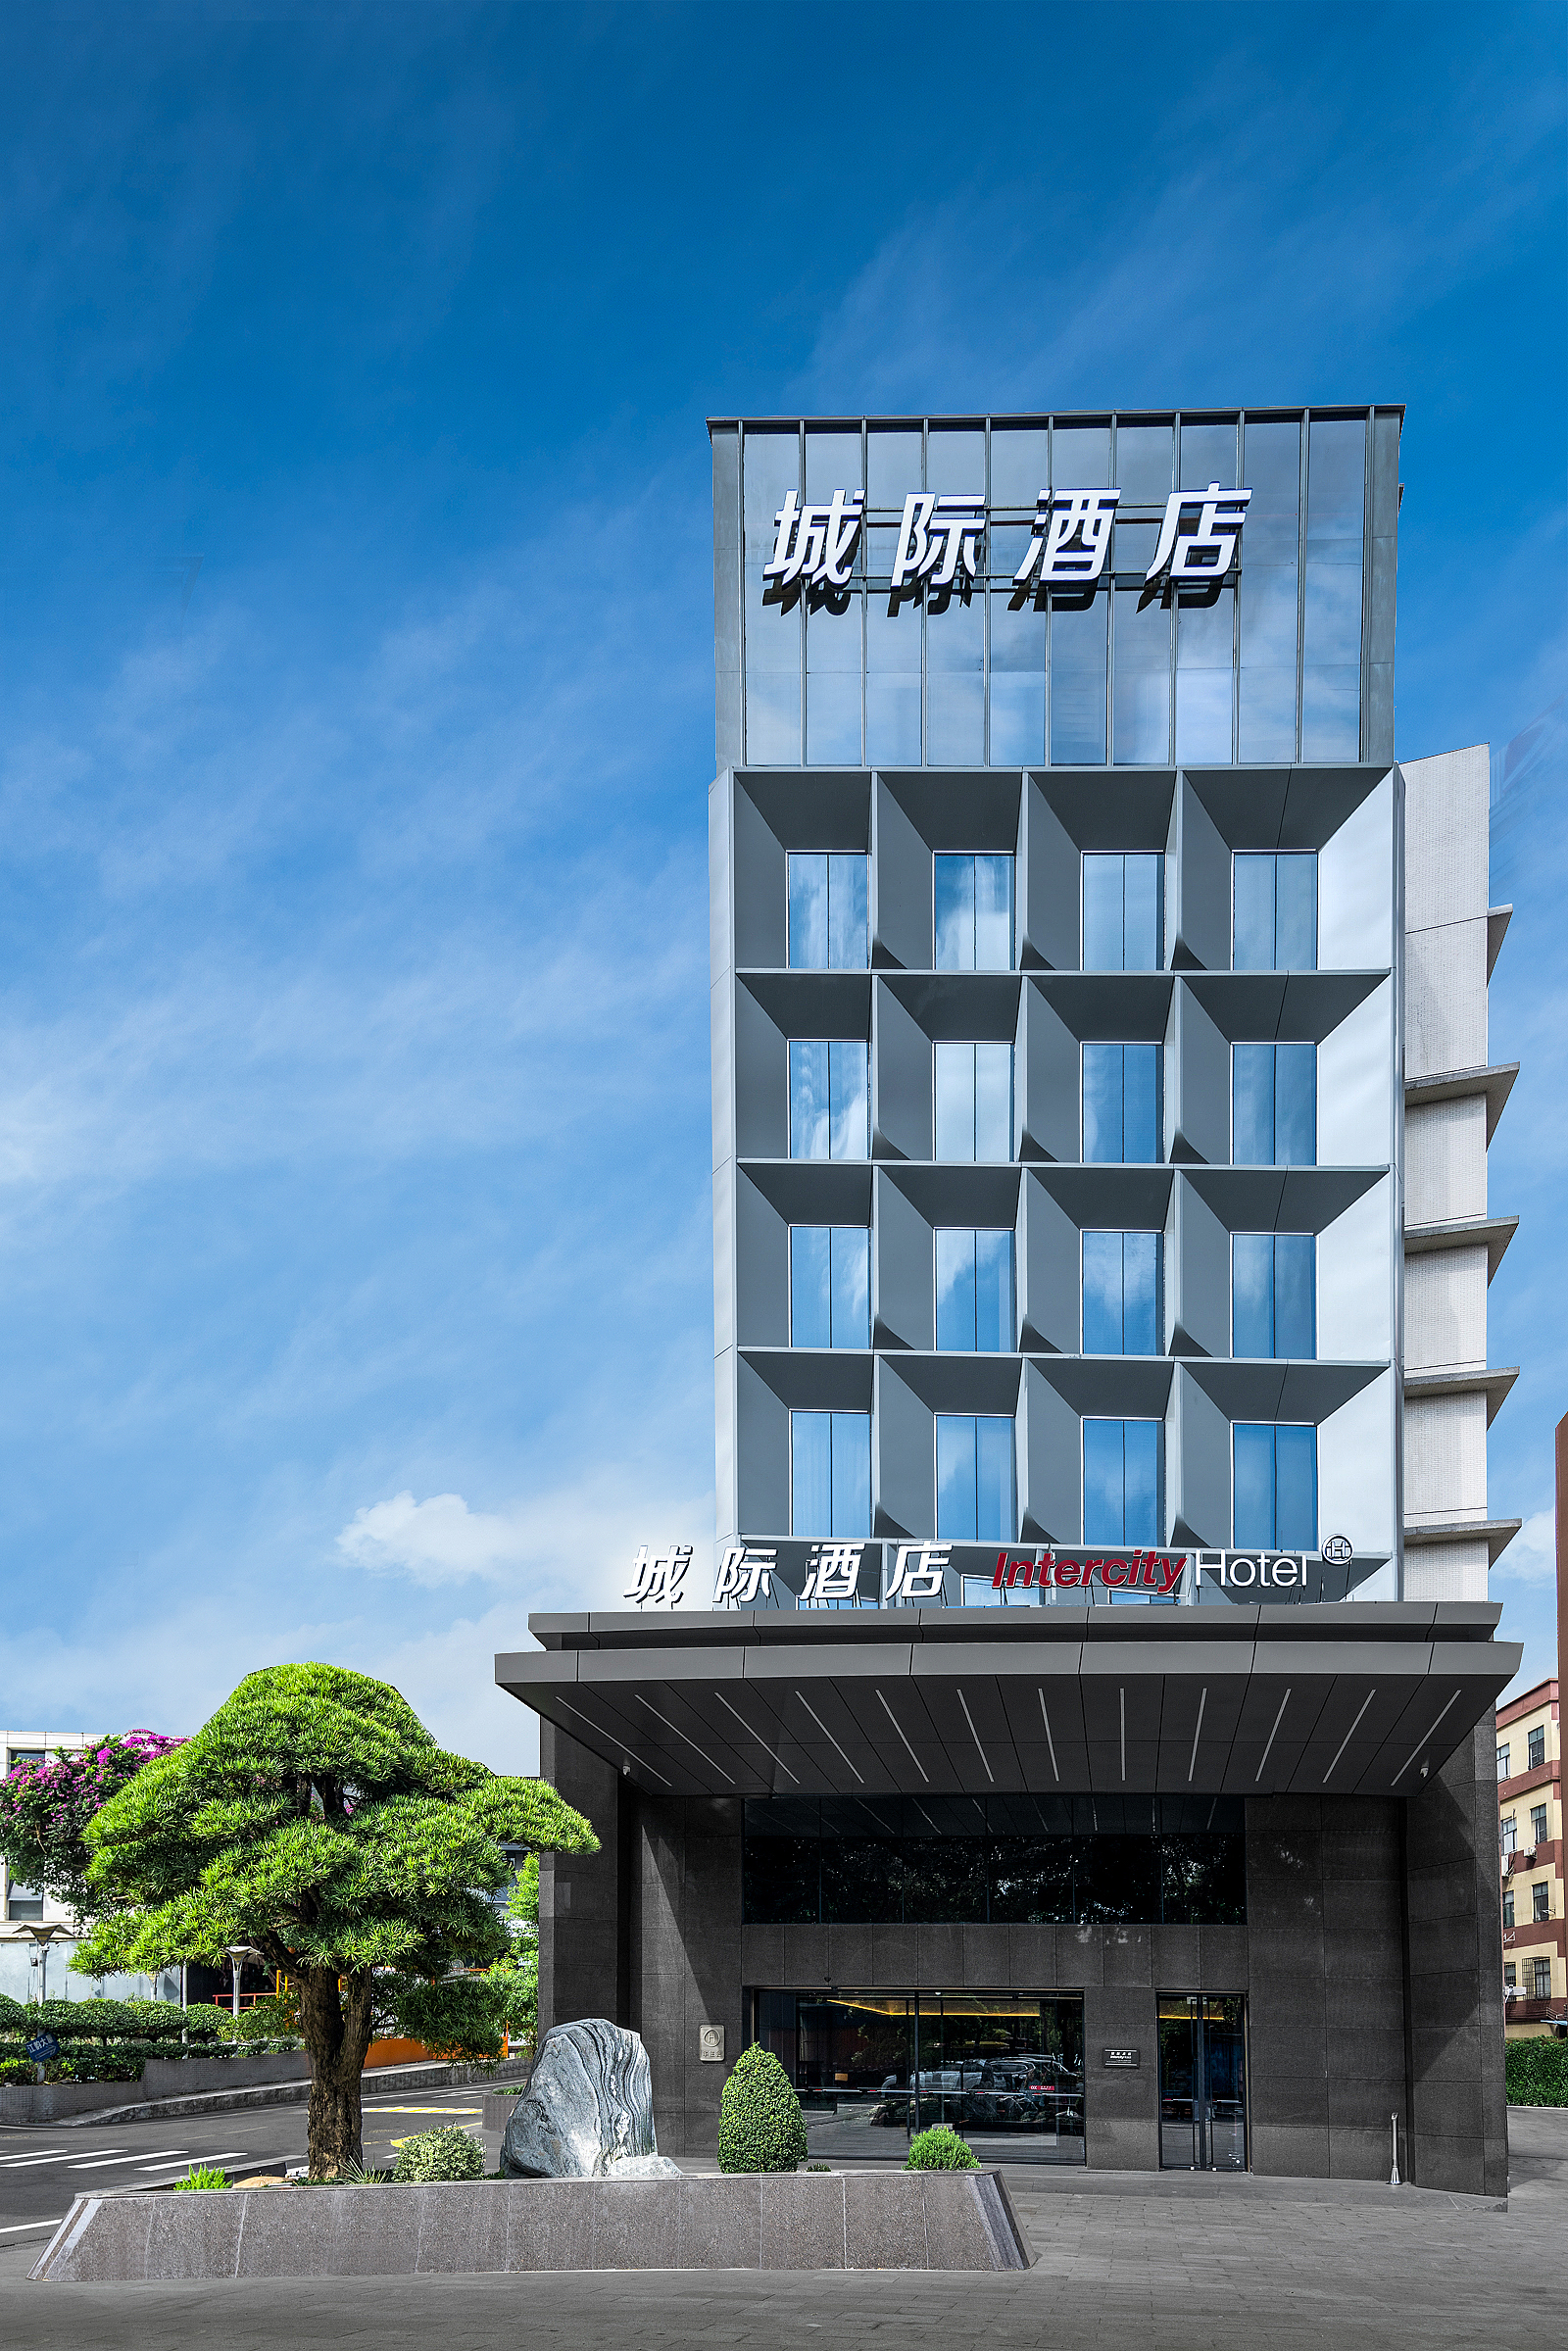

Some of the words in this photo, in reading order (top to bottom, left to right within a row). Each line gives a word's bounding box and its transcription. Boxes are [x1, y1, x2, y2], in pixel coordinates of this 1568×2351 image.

[763, 481, 1253, 586] 城际酒店
[622, 1541, 954, 1604] 城际酒店
